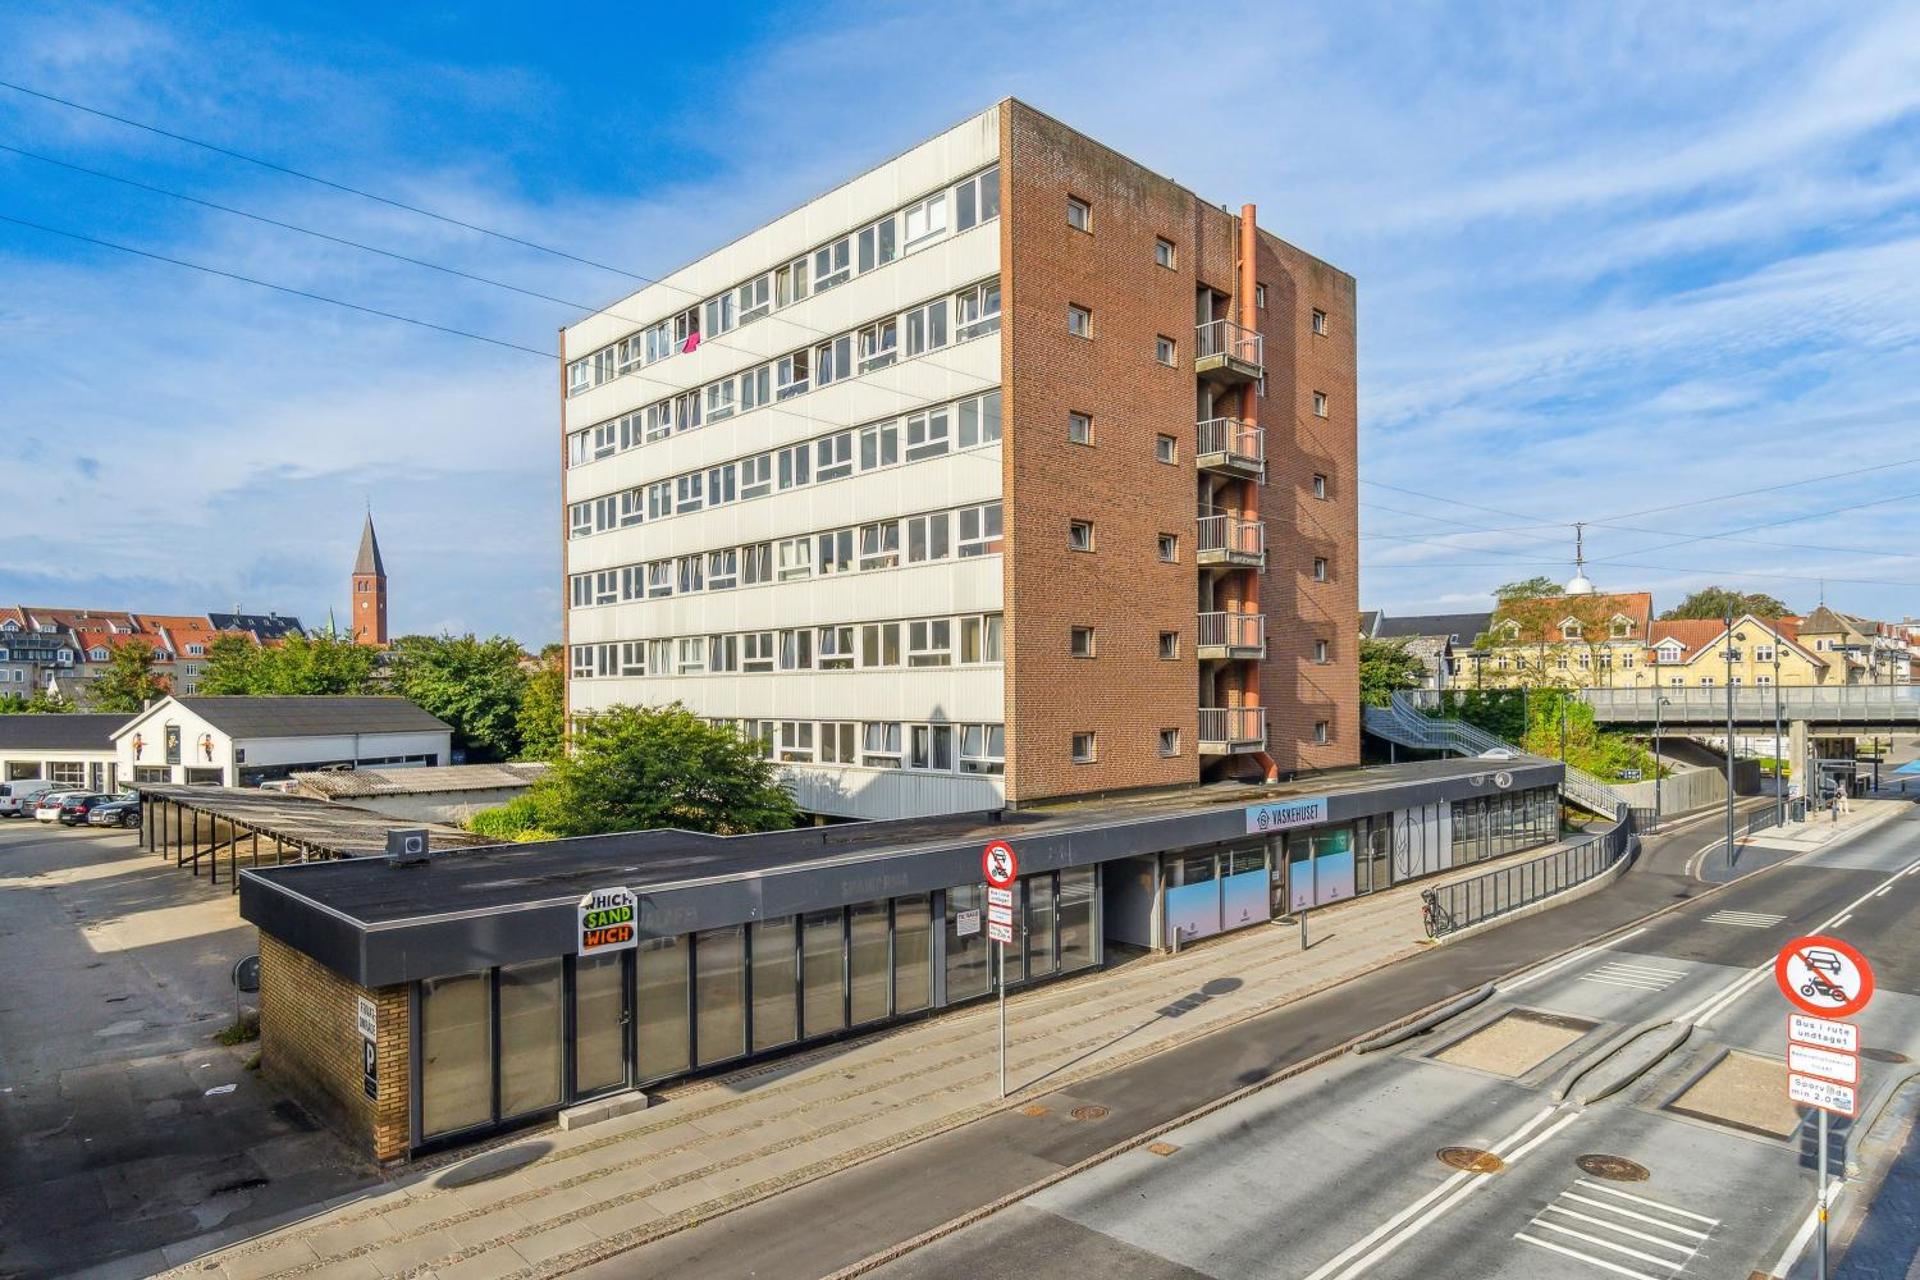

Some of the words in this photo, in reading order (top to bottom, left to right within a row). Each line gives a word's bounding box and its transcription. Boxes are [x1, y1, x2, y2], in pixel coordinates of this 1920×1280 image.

[1272, 805, 1318, 824] VASKEHUSET
[588, 907, 630, 928] SAND
[587, 927, 629, 945] WICH
[366, 1042, 375, 1074] P
